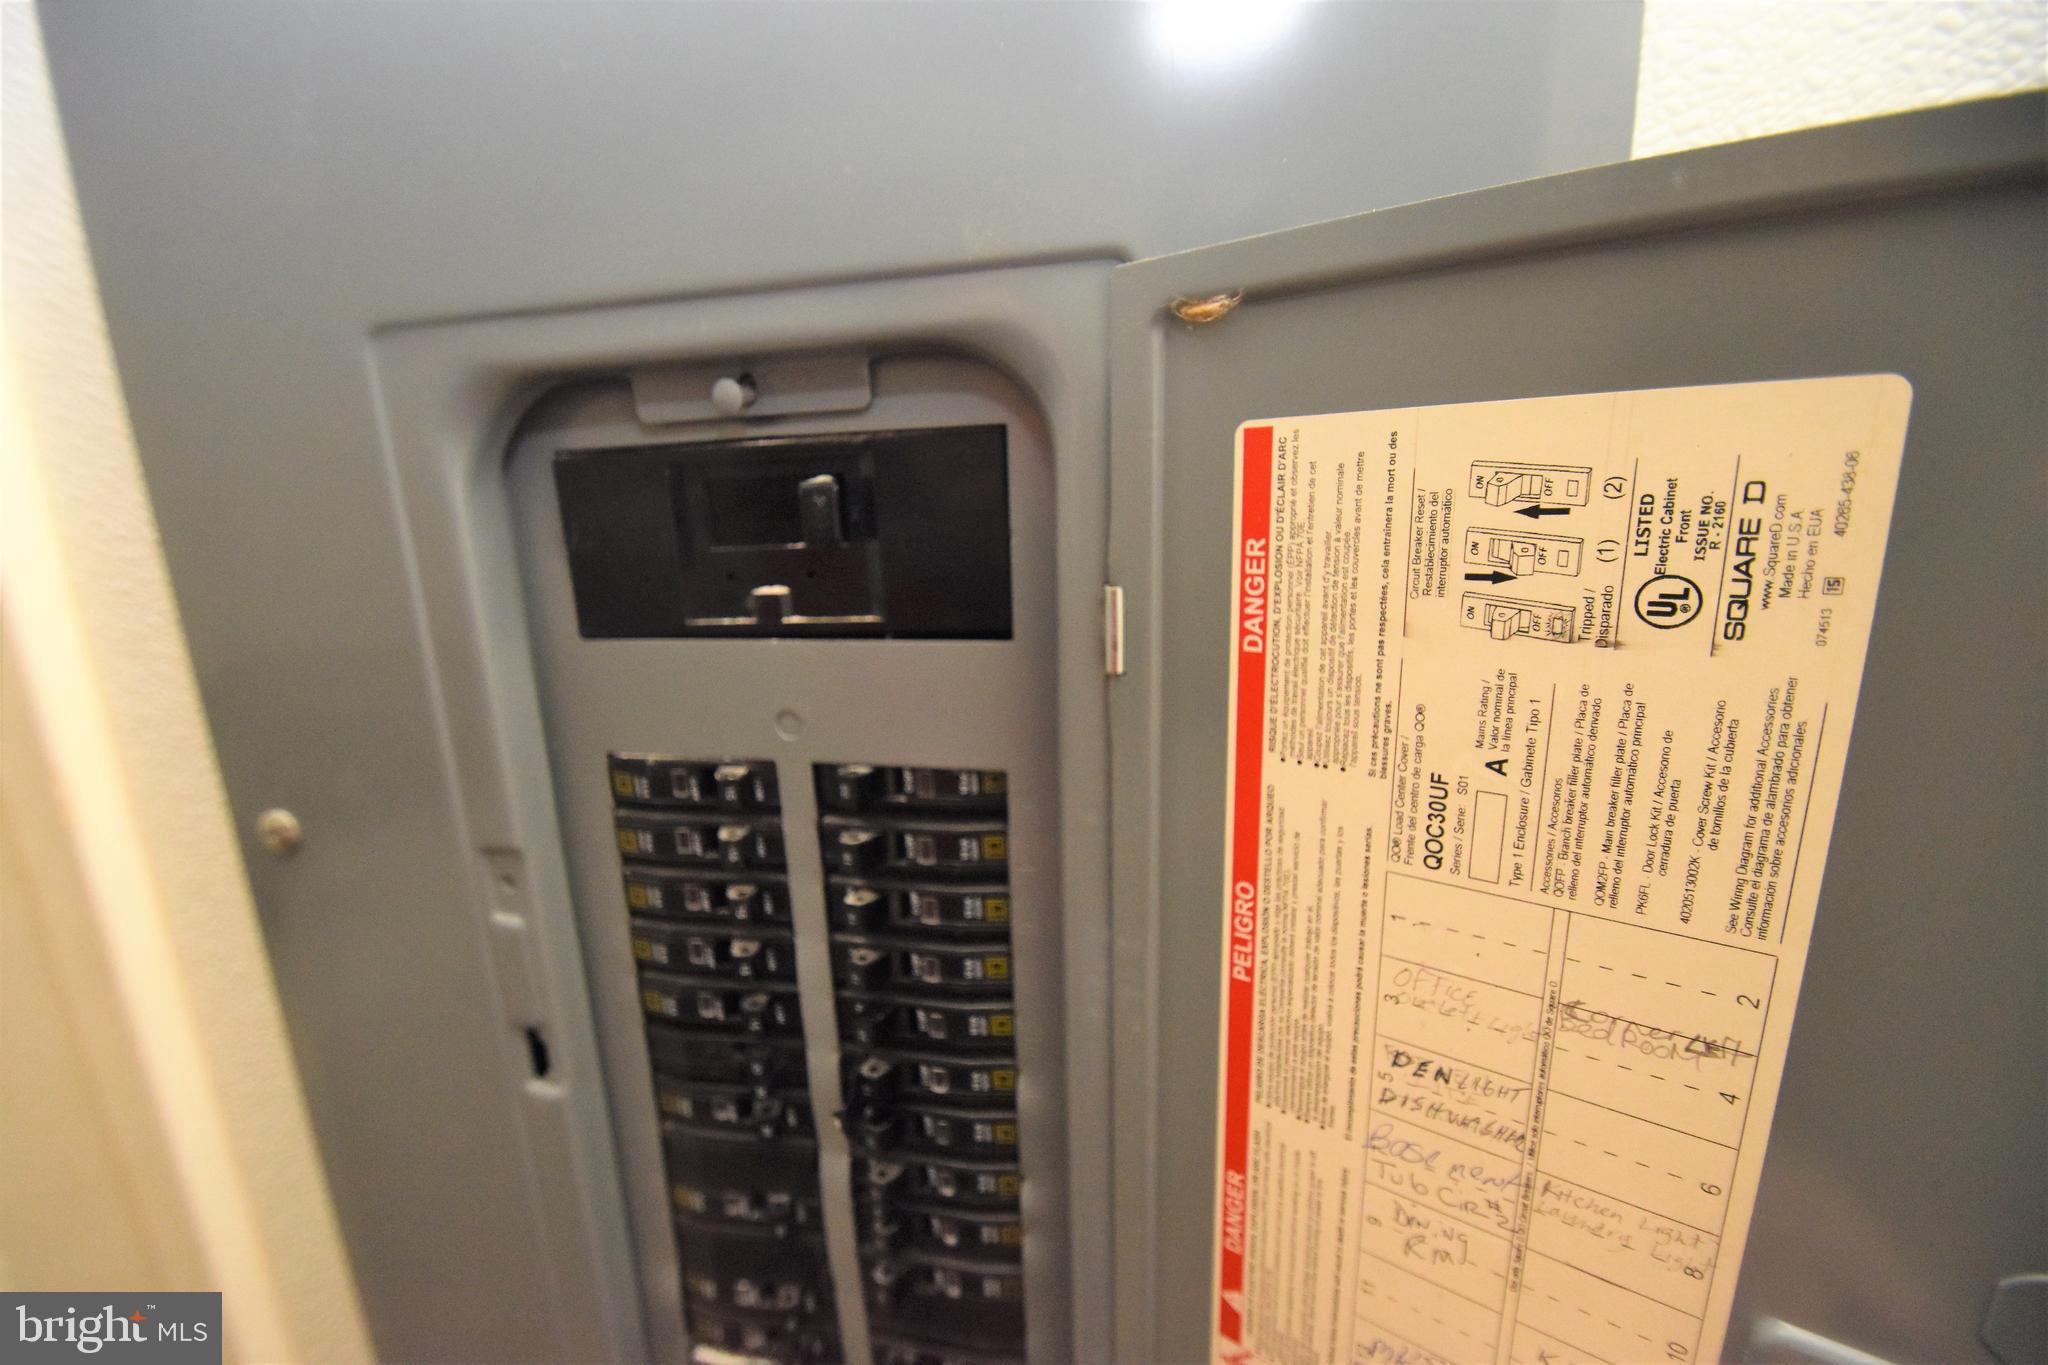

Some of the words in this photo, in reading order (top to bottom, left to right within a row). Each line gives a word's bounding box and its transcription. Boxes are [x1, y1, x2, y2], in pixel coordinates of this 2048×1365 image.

[1476, 475, 1485, 489] ON
[1544, 477, 1554, 496] OFF
[1604, 476, 1628, 499] (2)
[1415, 494, 1426, 523] Reset
[1429, 492, 1439, 506] del
[1661, 478, 1678, 524] Cabinet
[1700, 491, 1714, 515] NO.
[1712, 501, 1727, 528] 2160
[1441, 488, 1453, 544] automático
[1634, 494, 1655, 556] LISTED
[1675, 510, 1692, 543] Front
[1412, 526, 1423, 565] Breaker
[1422, 510, 1438, 596] Restablecimiento
[1471, 541, 1479, 555] ON
[1538, 547, 1547, 565] OFF
[1596, 540, 1620, 562] (1)
[1654, 528, 1672, 574] Electric
[1694, 520, 1710, 561] ISSUE
[1762, 494, 1787, 610] www.SquareD.com
[1797, 559, 1816, 599] Hecho
[1807, 509, 1824, 536] EUA
[1435, 547, 1449, 597] interruptor
[1724, 518, 1762, 641] SQUARE
[1743, 480, 1766, 504] D
[1244, 537, 1267, 653] DANGER
[1410, 568, 1420, 599] Circuit
[1778, 565, 1796, 598] Made
[1595, 585, 1614, 648] Disparado
[1646, 587, 1690, 617] UL
[1530, 612, 1542, 632] OFF
[1578, 596, 1595, 641] Tripped
[1816, 608, 1833, 646] 074513
[1496, 668, 1505, 681] de
[1624, 683, 1634, 696] de
[1478, 686, 1491, 717] Rating
[1493, 684, 1504, 722] nominal
[1501, 744, 1510, 752] la
[1507, 672, 1518, 714] principal
[1780, 677, 1798, 719] obtener
[1526, 709, 1541, 733] Tipo
[1574, 700, 1588, 728] Placa
[1587, 698, 1602, 741] derivado
[1618, 700, 1632, 729] Placa
[1633, 702, 1646, 746] principal
[1707, 700, 1726, 754] Accesorio
[1757, 688, 1780, 756] Accessories
[1414, 735, 1426, 764] carga
[1475, 720, 1486, 749] Mains
[1489, 725, 1500, 750] Valor
[1662, 730, 1674, 743] de
[1723, 719, 1740, 762] cubierta
[1778, 723, 1790, 748] para
[1398, 742, 1409, 772] Cover
[1520, 737, 1536, 787] Gabinete
[1615, 738, 1627, 764] plate
[1485, 759, 1509, 776] A
[1581, 744, 1596, 799] automático
[1610, 767, 1623, 787] filler
[1624, 749, 1640, 805] automático
[1653, 746, 1671, 798] Accesorio
[1704, 764, 1717, 778] Kit
[1719, 766, 1732, 775] la
[1765, 751, 1785, 809] alambrado
[1395, 774, 1406, 808] Center
[1410, 782, 1420, 813] centro
[1669, 779, 1681, 811] puerta
[1697, 781, 1713, 814] Screw
[1717, 778, 1730, 792] de
[1749, 760, 1767, 812] additional
[1423, 772, 1449, 870] QOC30UF
[1562, 788, 1577, 824] breaker
[1605, 790, 1619, 827] breaker
[1650, 807, 1662, 820] Kit
[1665, 814, 1676, 827] de
[1744, 814, 1757, 828] for
[1761, 812, 1774, 826] de
[1776, 788, 1795, 846] accesorios
[1394, 810, 1404, 835] Load
[1407, 816, 1417, 831] del
[1450, 843, 1463, 875] Series
[1457, 776, 1469, 795] S01
[1513, 797, 1530, 850] Enclosure
[1540, 839, 1556, 894] Accessories
[1548, 778, 1563, 830] Accesorios
[1575, 801, 1589, 849] interruptor
[1616, 808, 1631, 857] interruptor
[1646, 823, 1660, 847] Lock
[1692, 817, 1707, 846] Cover
[1404, 834, 1416, 866] Frente
[1558, 827, 1572, 860] Branch
[1601, 830, 1614, 853] Main
[1659, 830, 1673, 876] cerradura
[1707, 838, 1719, 851] de
[1735, 832, 1754, 875] Diagram
[1752, 829, 1771, 878] diagrama
[1509, 862, 1524, 886] Type
[1572, 852, 1582, 866] del
[1612, 859, 1624, 874] del
[1642, 849, 1655, 873] Door
[1769, 849, 1784, 878] sobre
[1553, 868, 1565, 897] QOFP
[1568, 869, 1580, 900] relleno
[1594, 862, 1609, 906] QOM2FP
[1609, 877, 1621, 909] relleno
[1680, 856, 1701, 924] 4020513002K
[1729, 878, 1748, 910] Wiring
[1750, 880, 1761, 890] el
[1636, 884, 1651, 915] PK6FL
[1740, 892, 1759, 937] Consulte
[1757, 881, 1777, 940] información
[1232, 880, 1254, 982] PELIGRO
[1725, 914, 1739, 934] See
[1736, 994, 1760, 1010] 2
[1391, 1050, 1452, 1084] DEN
[1719, 1090, 1740, 1104] 4
[1700, 1182, 1722, 1197] 6
[1223, 1168, 1245, 1254] DANGER
[1683, 1266, 1704, 1280] 8
[1666, 1342, 1688, 1362] 10
